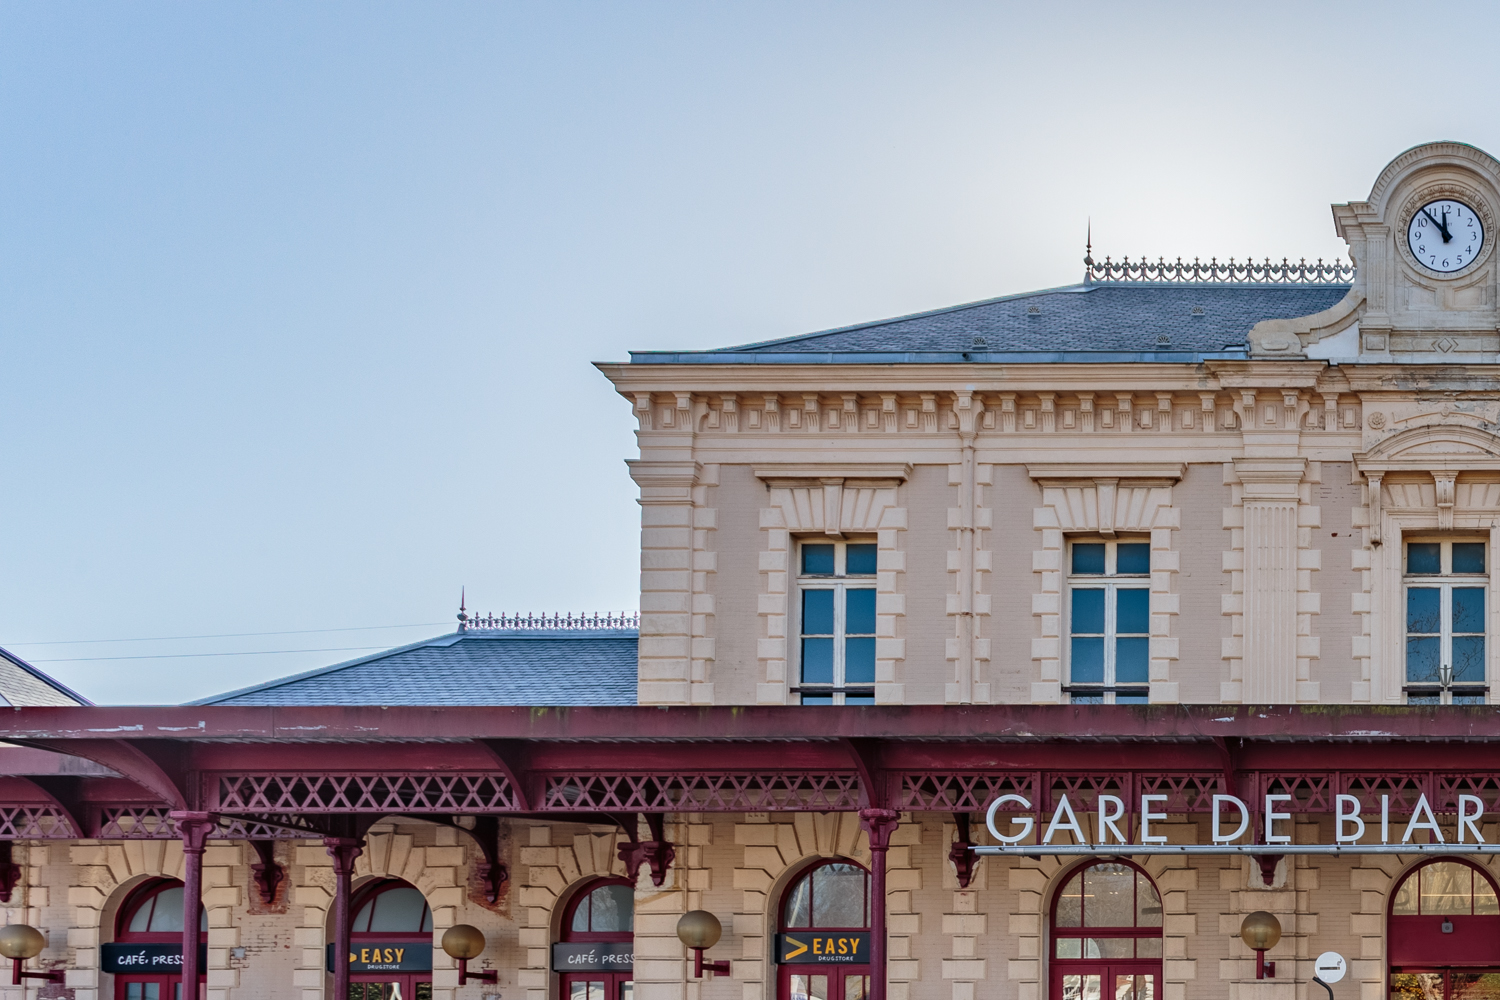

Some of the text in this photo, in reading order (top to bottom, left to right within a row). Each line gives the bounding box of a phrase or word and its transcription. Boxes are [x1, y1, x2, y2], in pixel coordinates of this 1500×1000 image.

[1429, 208, 1437, 217] 11
[1441, 205, 1451, 214] 12
[1457, 208, 1461, 217] 1
[1417, 217, 1428, 228] 10
[1467, 217, 1473, 227] 2
[1414, 231, 1422, 241] 9
[1470, 231, 1477, 241] 3
[1418, 244, 1426, 254] 8
[1465, 245, 1472, 255] 4
[1429, 255, 1436, 265] 7
[1442, 258, 1449, 268] 6
[1456, 254, 1463, 265] 5
[985, 793, 1169, 843] GARE
[1211, 793, 1292, 843] DE
[812, 938, 860, 955] EASY
[361, 948, 405, 963] EASY
